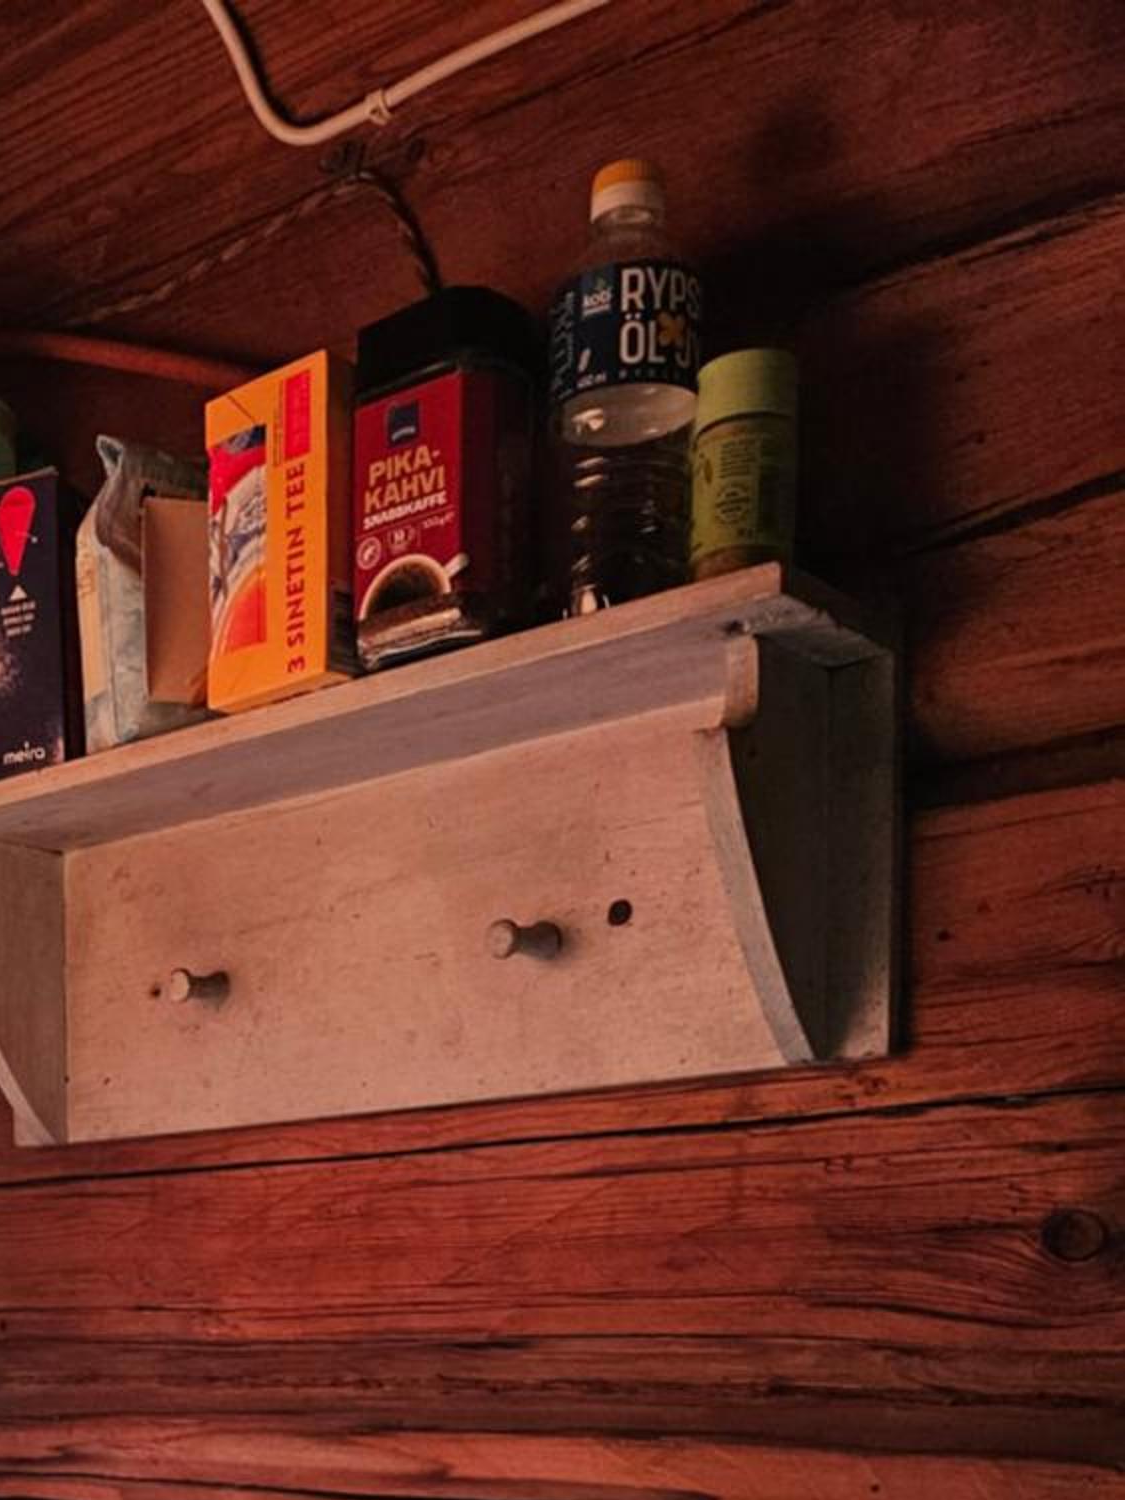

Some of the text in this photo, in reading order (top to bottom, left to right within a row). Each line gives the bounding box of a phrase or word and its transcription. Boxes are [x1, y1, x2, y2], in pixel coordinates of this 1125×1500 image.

[286, 463, 305, 519] TEE
[364, 464, 446, 514] KAHVI
[368, 445, 440, 487] PIKA-
[286, 526, 305, 647] SINETIN
[286, 656, 305, 673] 3
